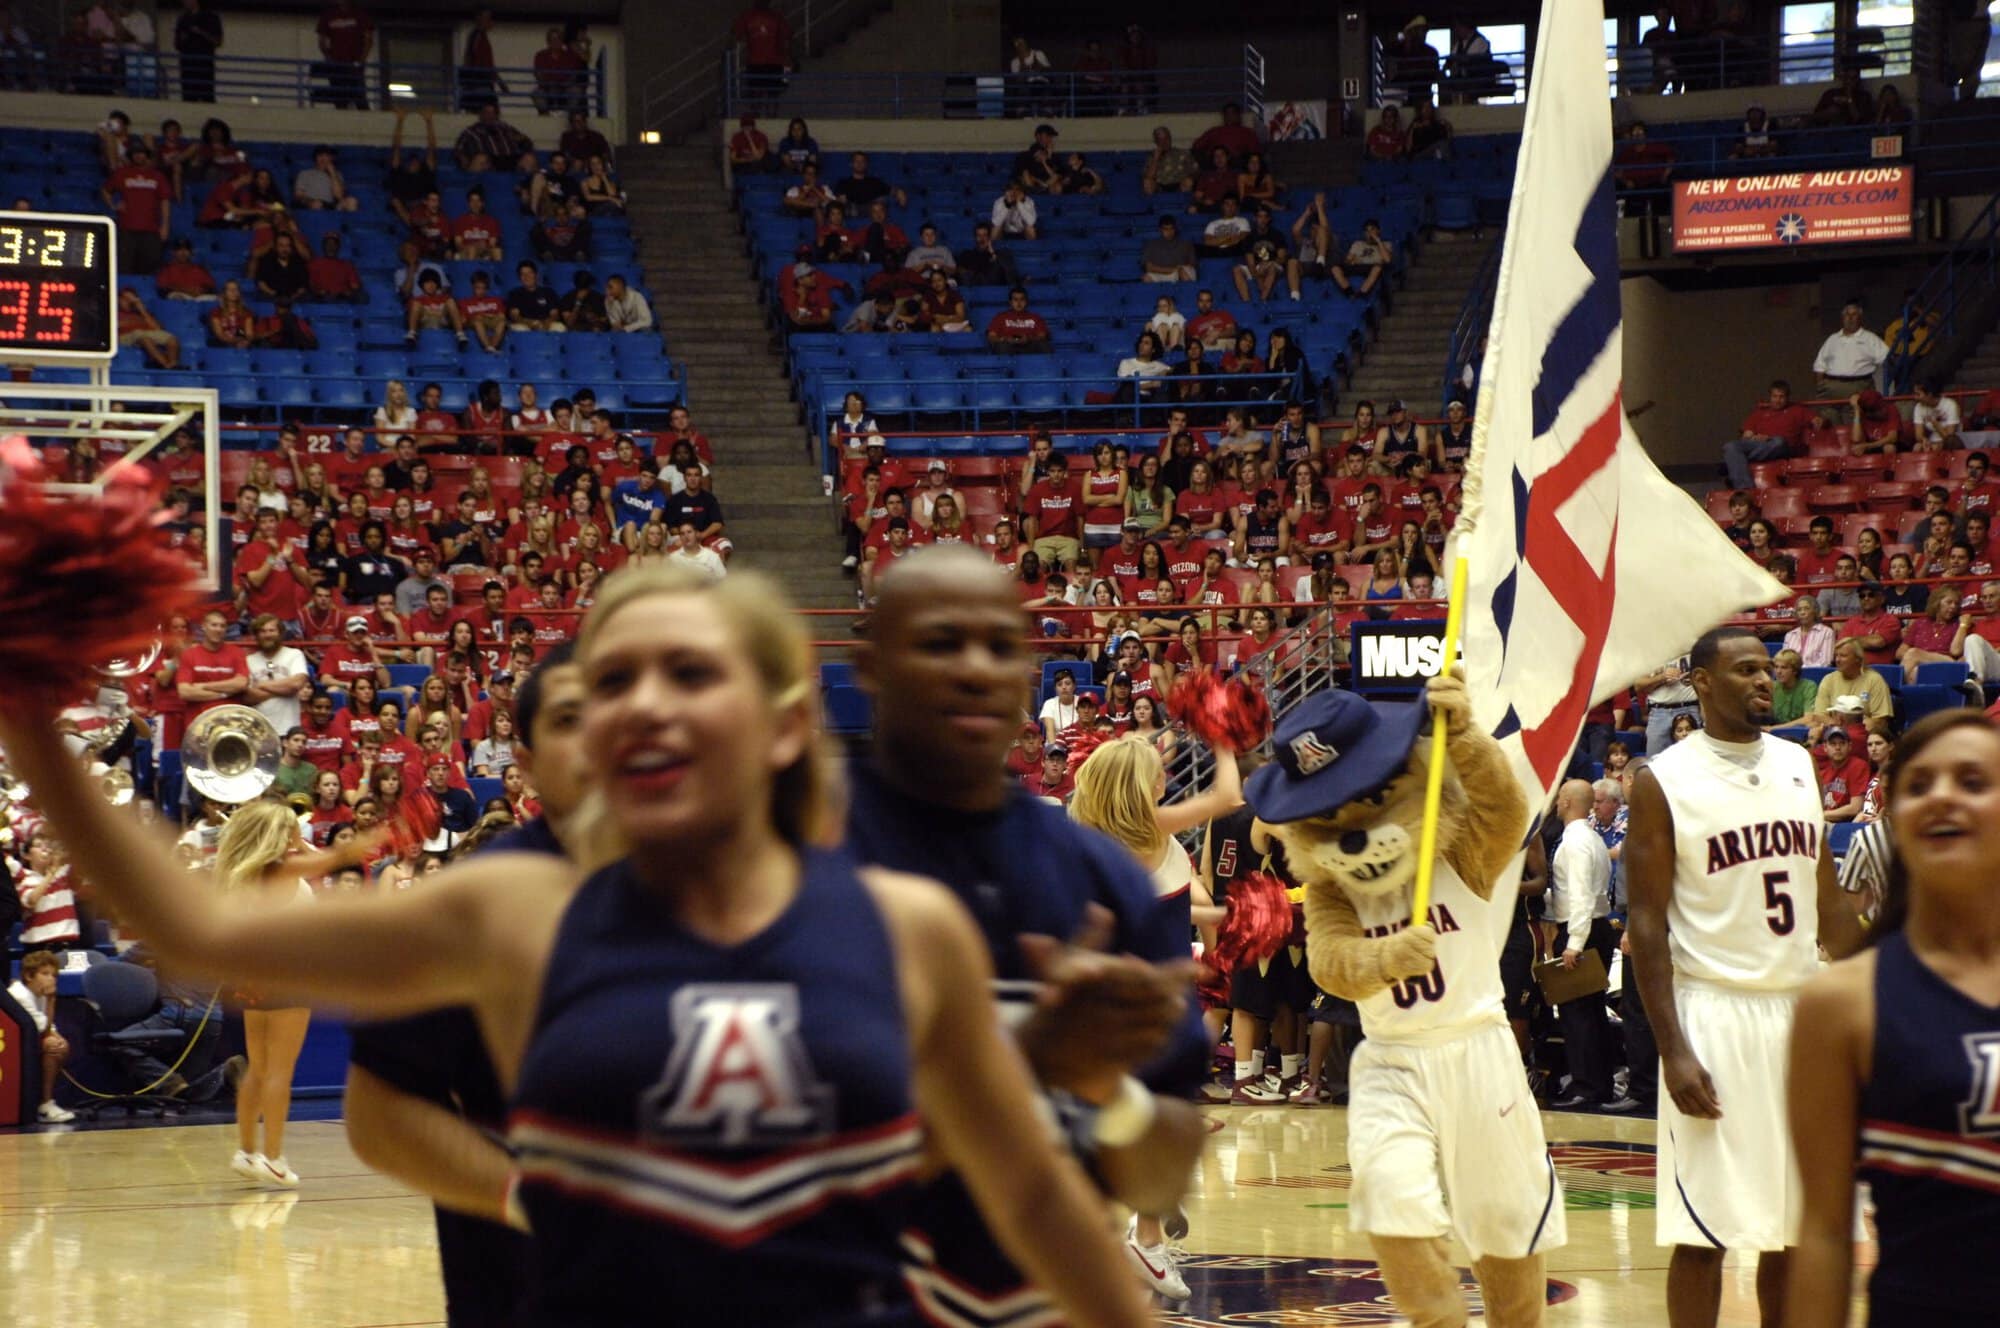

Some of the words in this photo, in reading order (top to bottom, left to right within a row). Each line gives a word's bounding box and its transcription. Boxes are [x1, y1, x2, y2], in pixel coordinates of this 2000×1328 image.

[1687, 179, 1729, 196] NEW
[1736, 172, 1803, 193] ONLINE
[1808, 167, 1903, 188] AUCTIONS
[1688, 188, 1899, 215] ARIZONAATHLETICS.COM
[0, 227, 95, 268] 3:21
[0, 281, 76, 340] 35
[307, 435, 331, 453] 22
[1216, 839, 1237, 877] 5
[1706, 819, 1817, 875] ARIZONA
[1762, 870, 1796, 937] 5
